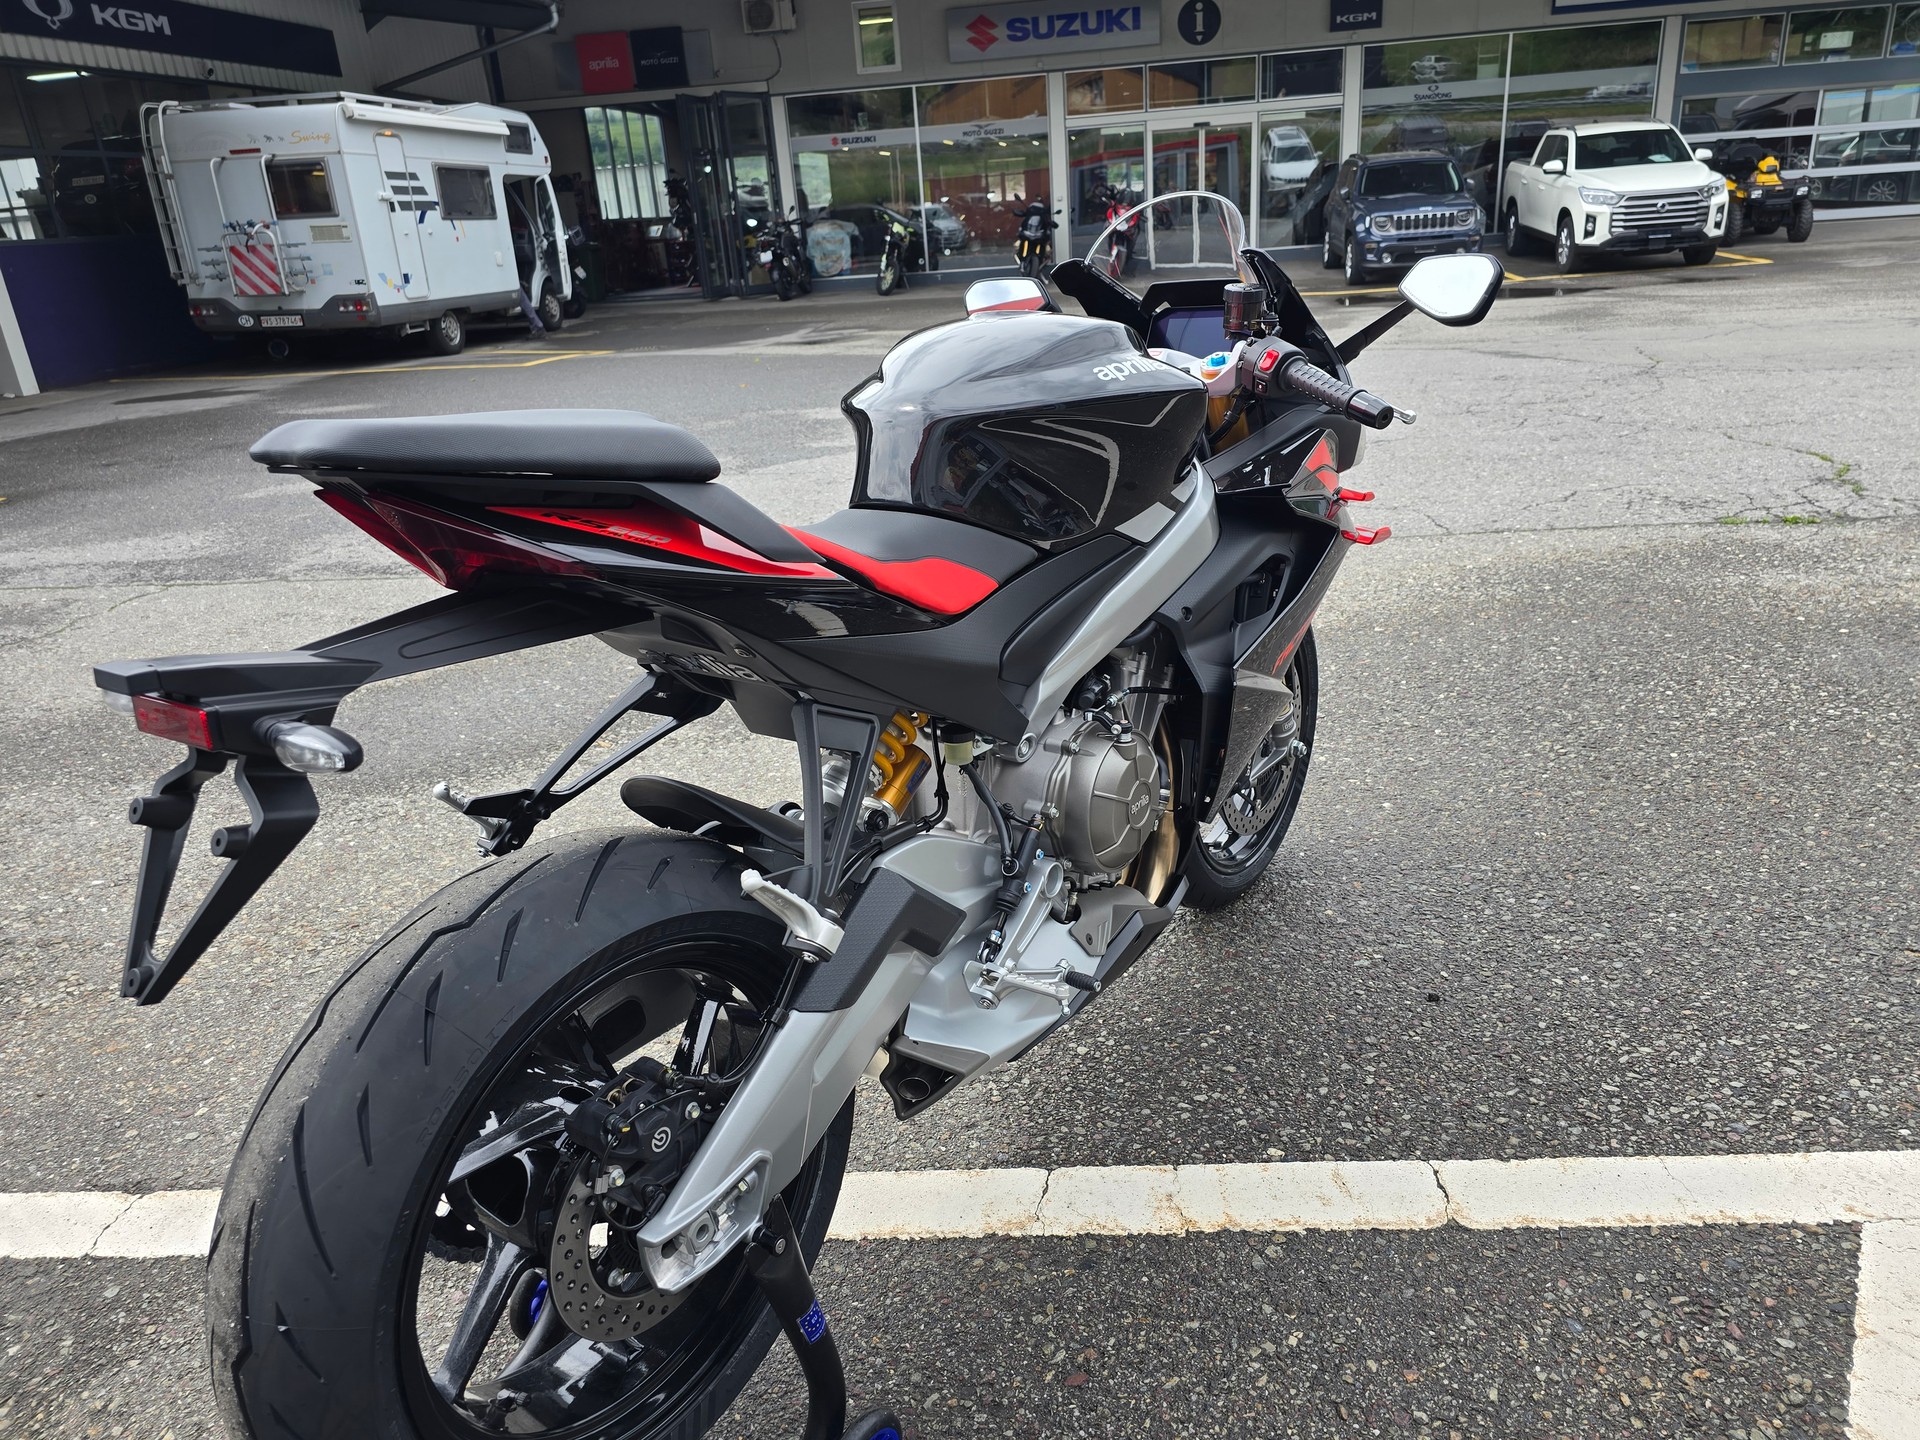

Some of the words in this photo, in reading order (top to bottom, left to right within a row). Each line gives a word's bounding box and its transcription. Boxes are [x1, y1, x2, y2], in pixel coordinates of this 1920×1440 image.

[90, 3, 172, 36] KGM
[1006, 6, 1141, 42] SUZUKI
[1336, 12, 1377, 24] KGM
[588, 56, 620, 71] aprilia
[640, 58, 659, 66] MOTO
[660, 56, 679, 64] GUZZI
[288, 130, 332, 145] Swing
[840, 135, 877, 145] SUZUKI
[962, 129, 982, 138] MOTO
[983, 128, 1005, 136] GUZZI
[240, 315, 252, 326] CH
[1093, 355, 1169, 381] aprilia
[1130, 794, 1150, 816] aprilia
[415, 1047, 484, 1148] ROSSO
